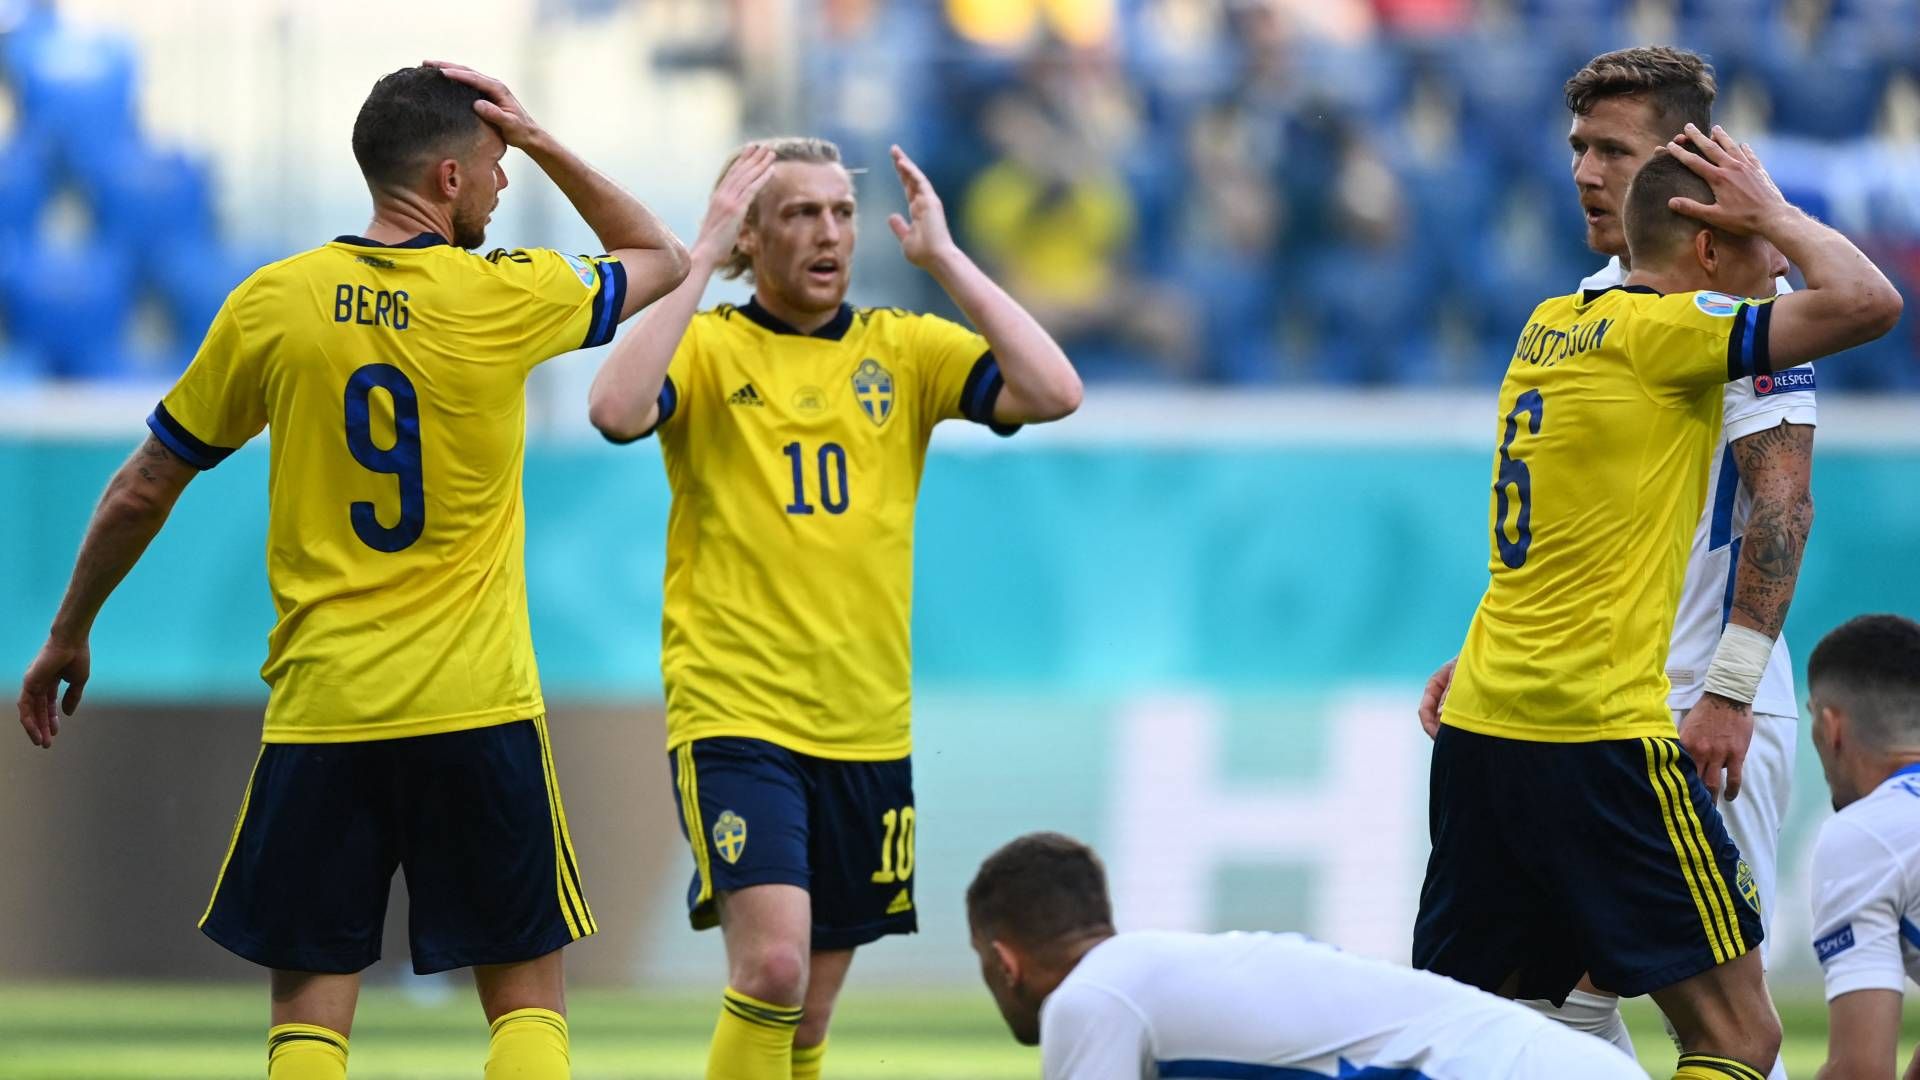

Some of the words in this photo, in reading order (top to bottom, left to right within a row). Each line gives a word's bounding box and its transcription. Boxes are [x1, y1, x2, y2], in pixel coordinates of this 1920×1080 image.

[334, 284, 410, 330] BERG
[1517, 318, 1614, 367] GUSTSSON
[1774, 374, 1814, 387] RESPECT
[344, 363, 425, 553] 9
[783, 441, 849, 515] 10
[1494, 388, 1544, 569] 6
[871, 805, 915, 883] 10
